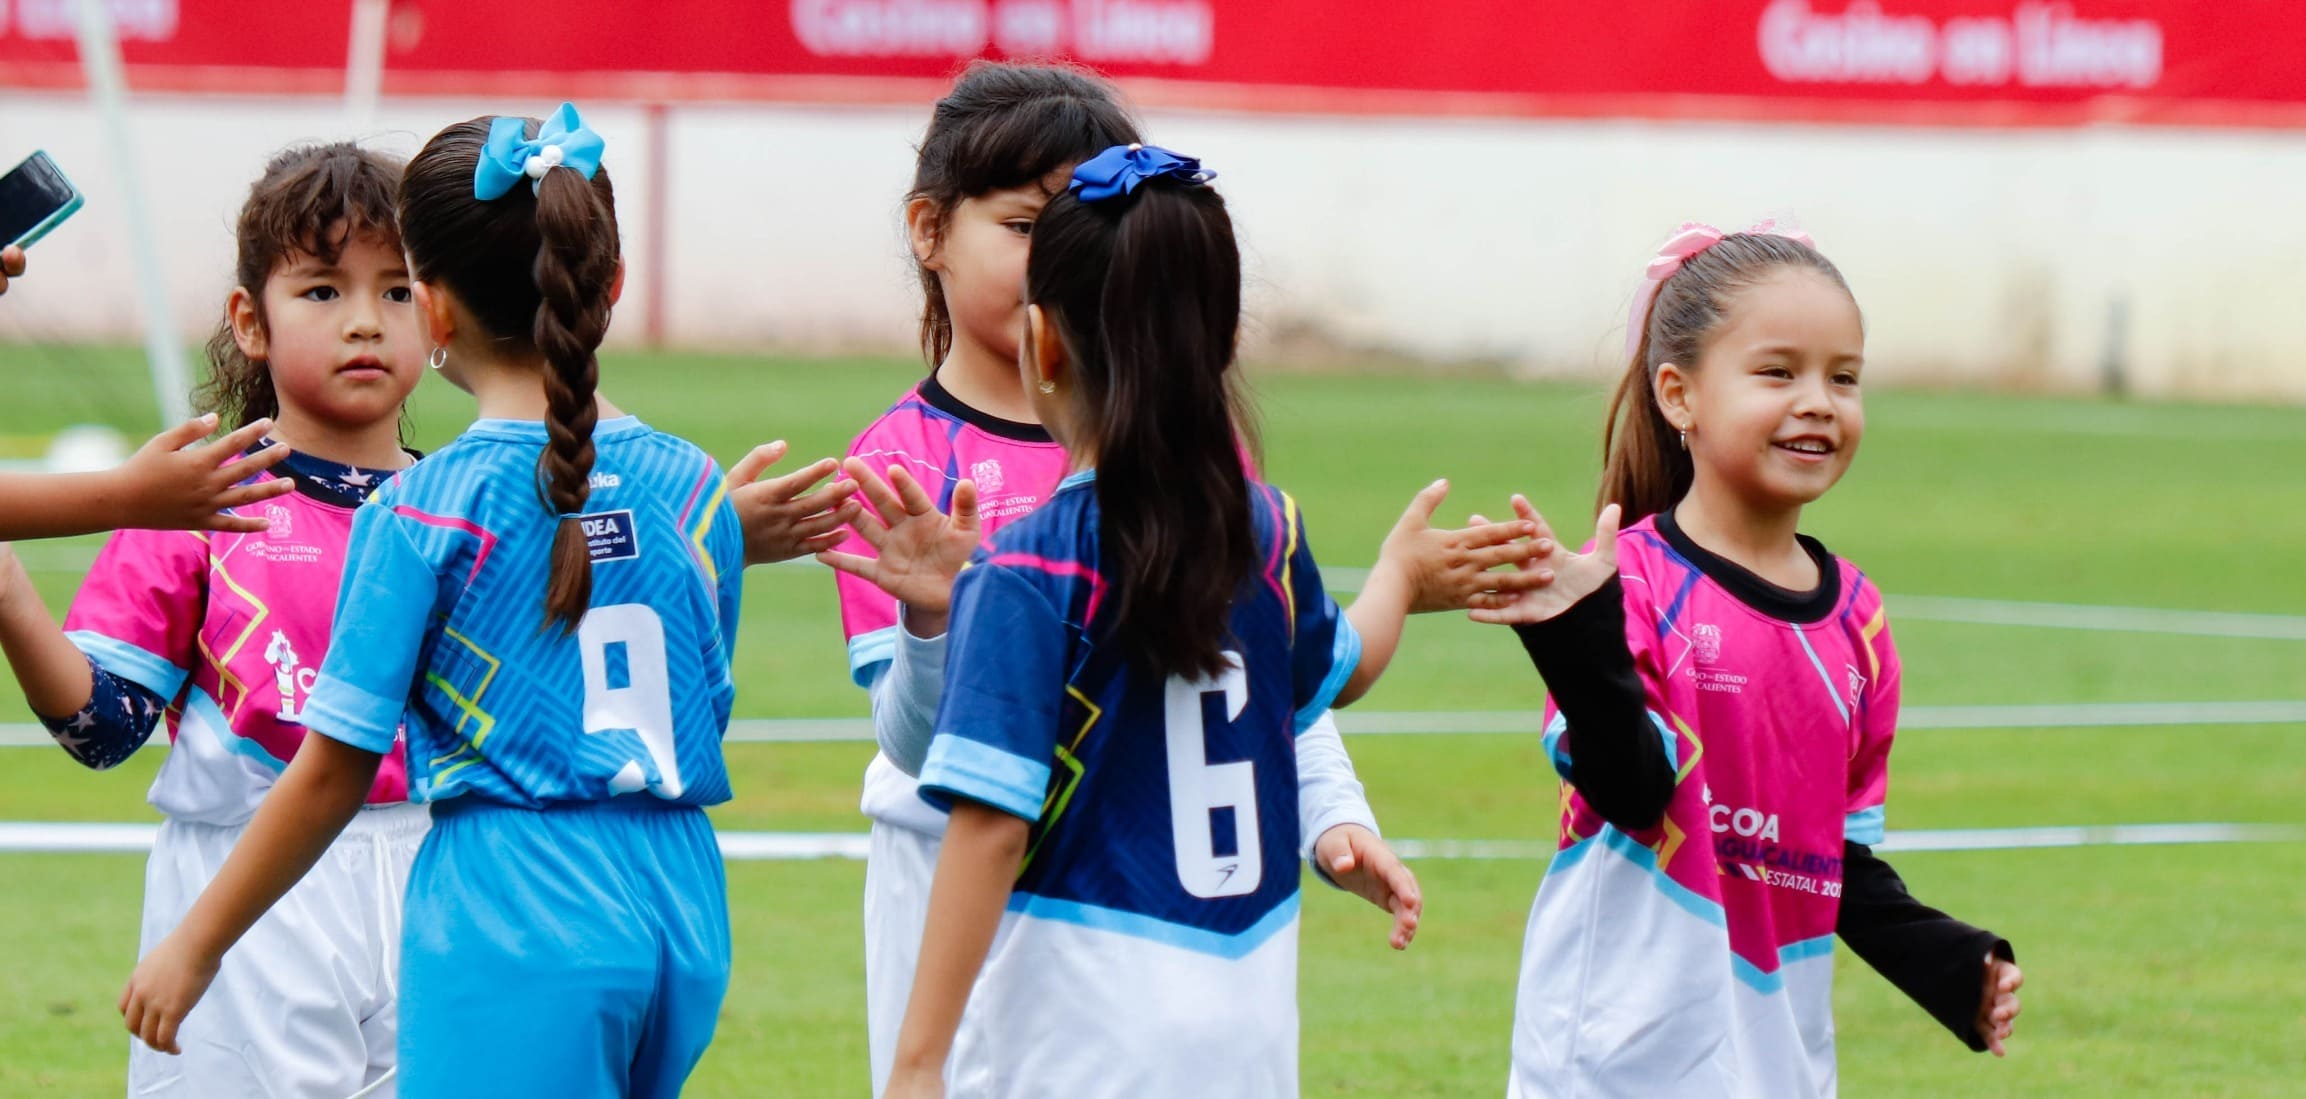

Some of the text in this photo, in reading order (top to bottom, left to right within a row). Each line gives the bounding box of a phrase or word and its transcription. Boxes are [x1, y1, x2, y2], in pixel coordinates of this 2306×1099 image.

[1006, 496, 1037, 506] ESTADO
[290, 545, 322, 555] ESTADO
[1714, 673, 1748, 685] ESTADO
[1696, 682, 1742, 694] CALIENTES
[578, 603, 684, 800] 9
[1164, 650, 1262, 898] 6
[1766, 869, 1842, 898] ESTATAL 20
